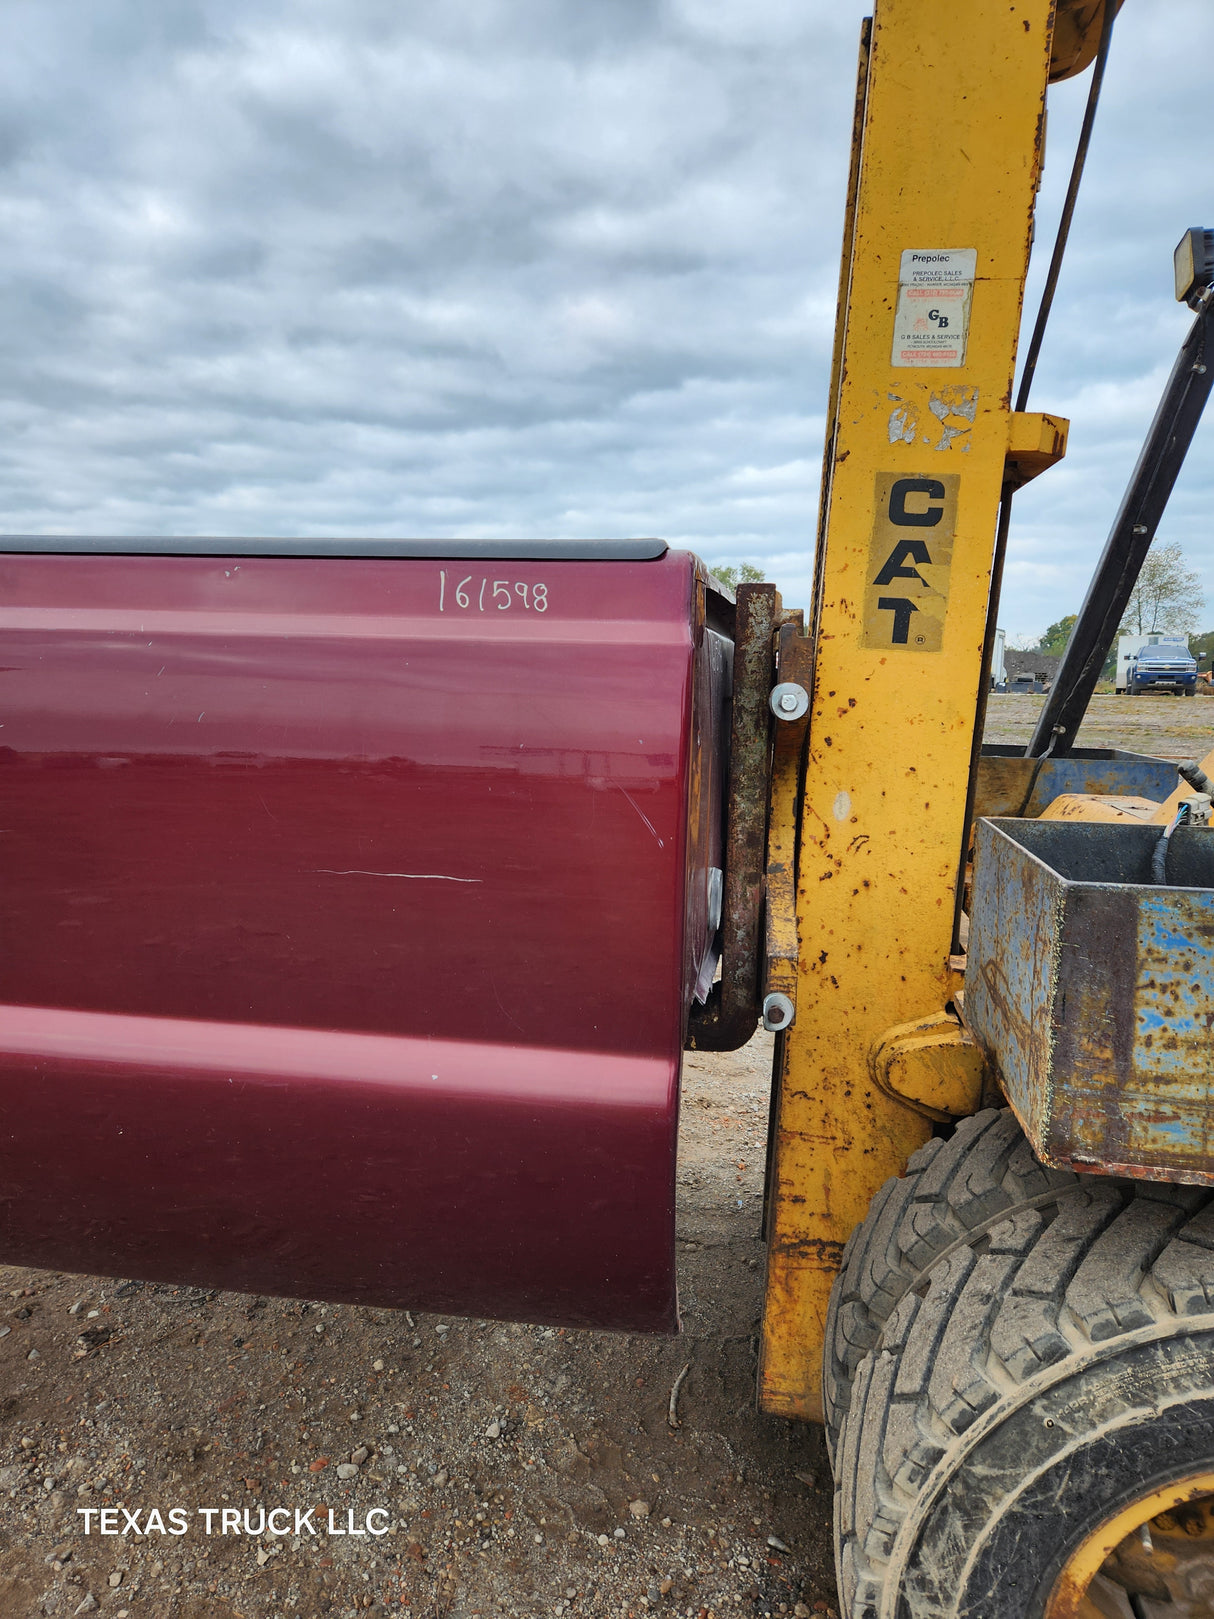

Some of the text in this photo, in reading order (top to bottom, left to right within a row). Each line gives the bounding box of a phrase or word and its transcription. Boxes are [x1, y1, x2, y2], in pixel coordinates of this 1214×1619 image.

[912, 254, 950, 263] Prepolec
[873, 478, 945, 644] CAT
[440, 570, 548, 612] 161598
